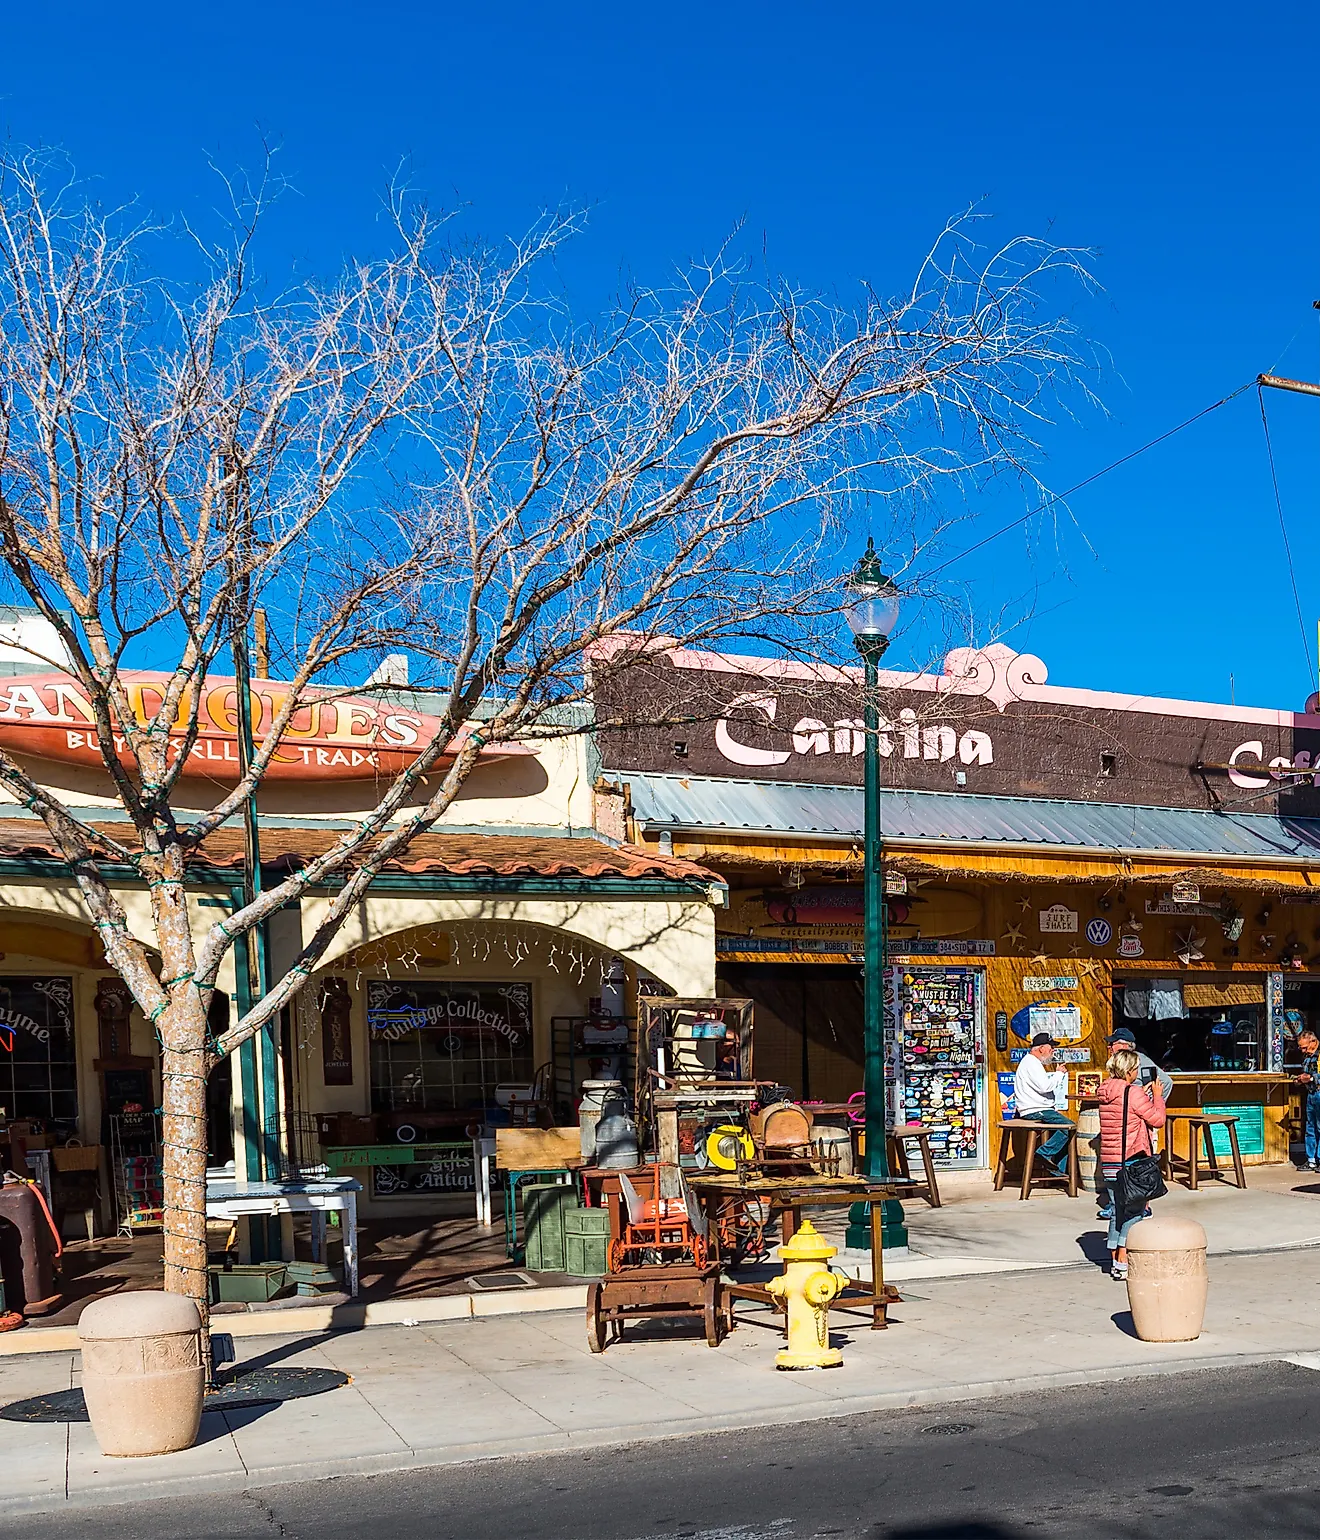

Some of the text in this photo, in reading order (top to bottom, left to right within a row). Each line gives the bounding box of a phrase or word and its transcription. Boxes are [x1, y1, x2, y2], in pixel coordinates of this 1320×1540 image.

[66, 730, 125, 752] BUY
[1047, 913, 1072, 922] SURF
[1045, 922, 1073, 930] SHACK
[1284, 982, 1301, 991] 512
[950, 990, 958, 999] 21
[383, 1000, 518, 1044] Vintage Collection
[330, 1015, 345, 1061] INDIAN
[949, 1050, 971, 1063] Nights
